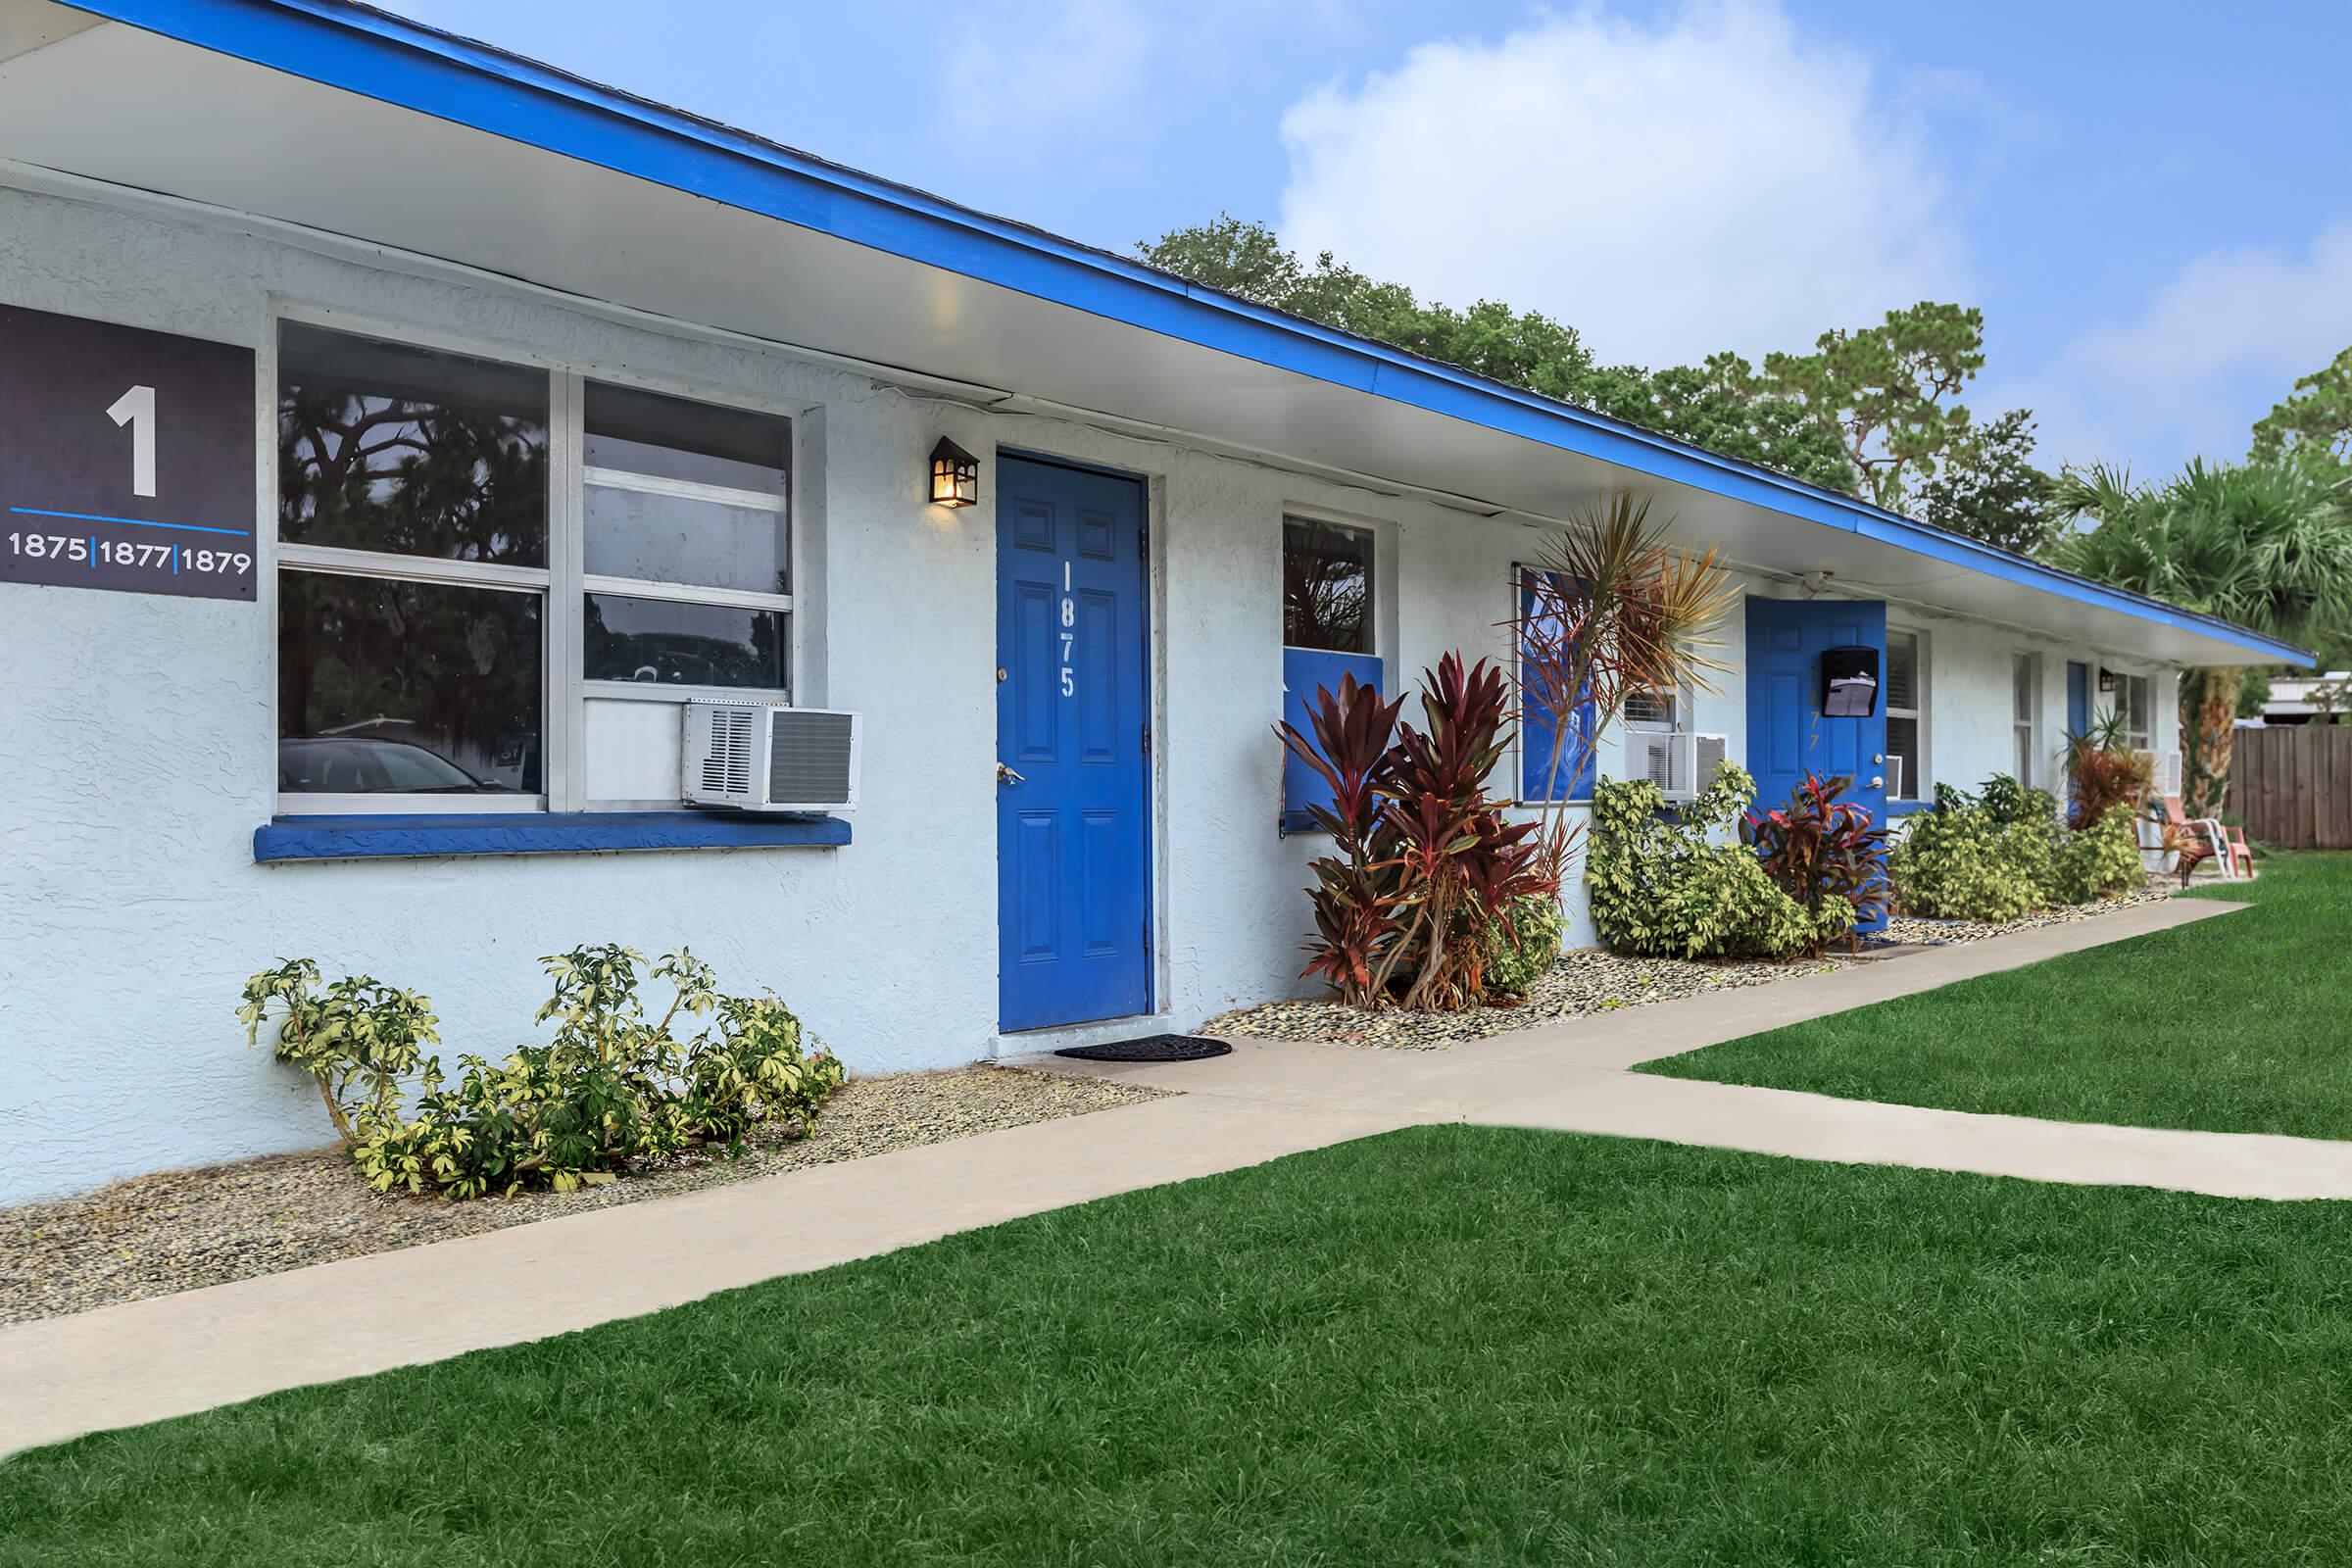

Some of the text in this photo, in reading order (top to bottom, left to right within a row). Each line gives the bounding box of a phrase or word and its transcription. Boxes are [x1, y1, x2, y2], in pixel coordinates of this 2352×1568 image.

[106, 384, 156, 498] 1
[9, 532, 251, 575] 1875 1877 1879
[1060, 561, 1074, 698] 1875
